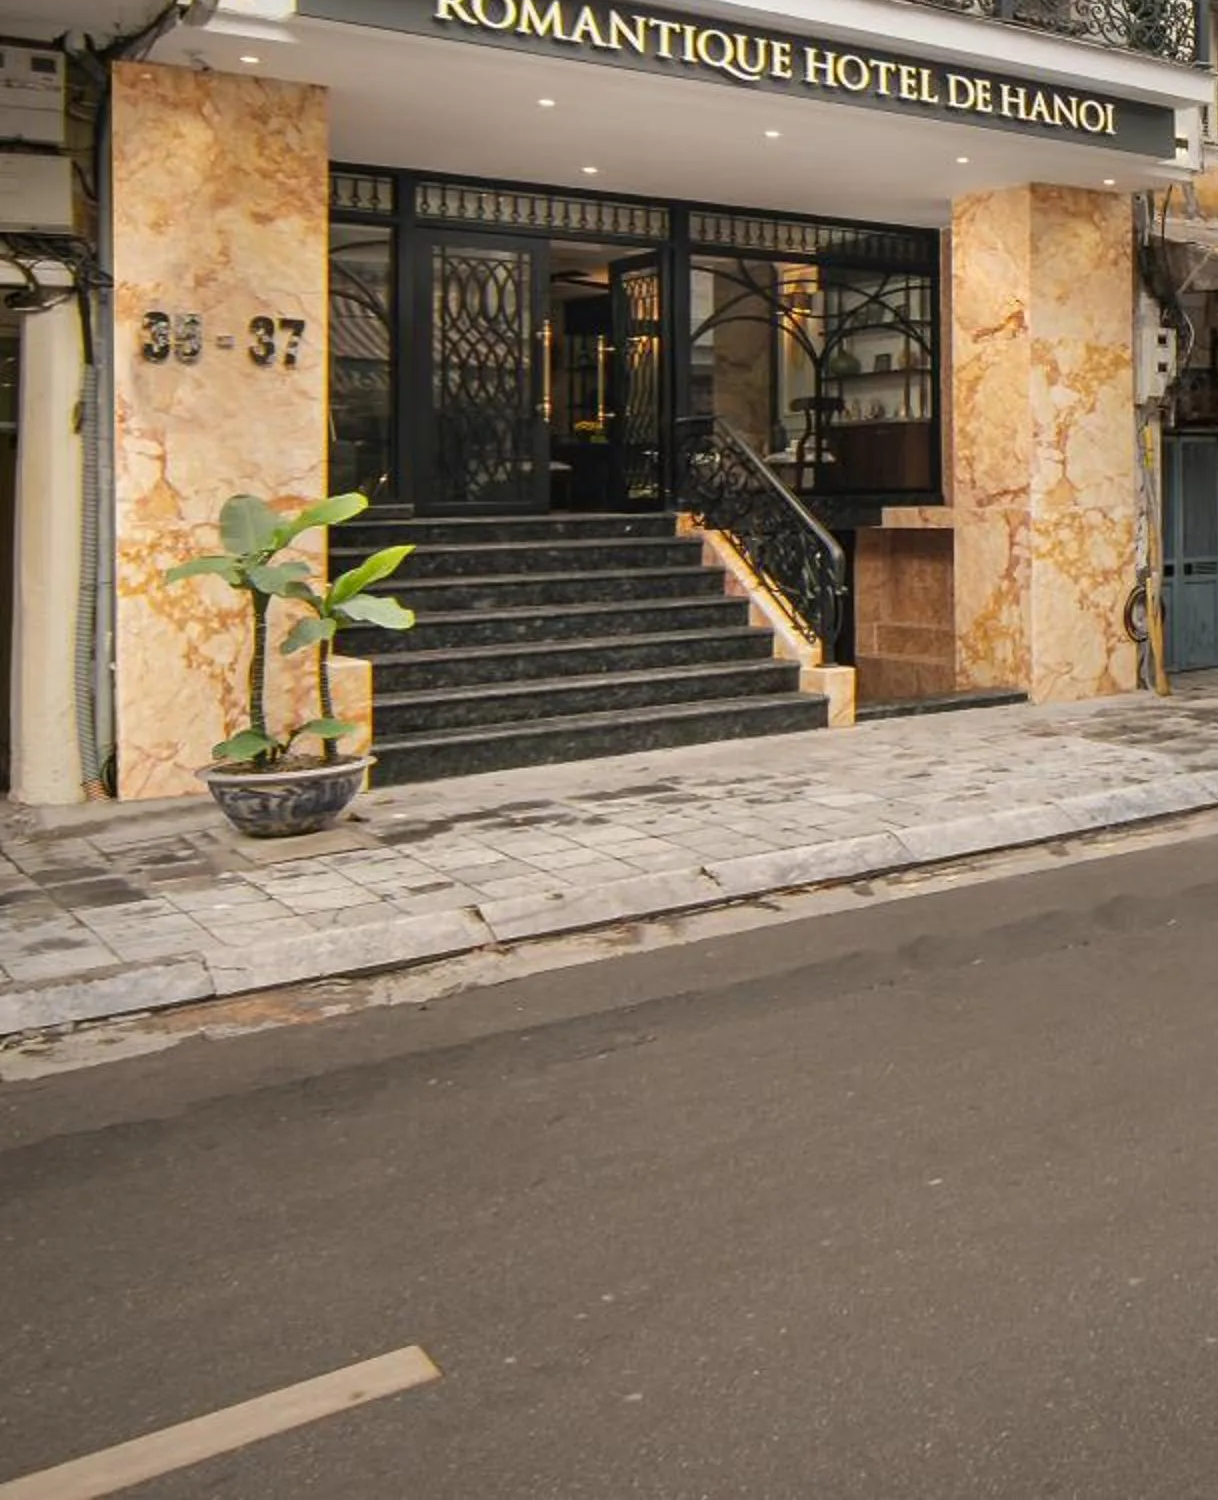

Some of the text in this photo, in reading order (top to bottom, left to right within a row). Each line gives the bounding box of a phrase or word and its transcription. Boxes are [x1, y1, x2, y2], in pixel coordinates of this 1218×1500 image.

[804, 47, 939, 104] HOTEL
[946, 72, 994, 113] DE
[1000, 82, 1118, 136] HANOI
[248, 315, 306, 371] 37
